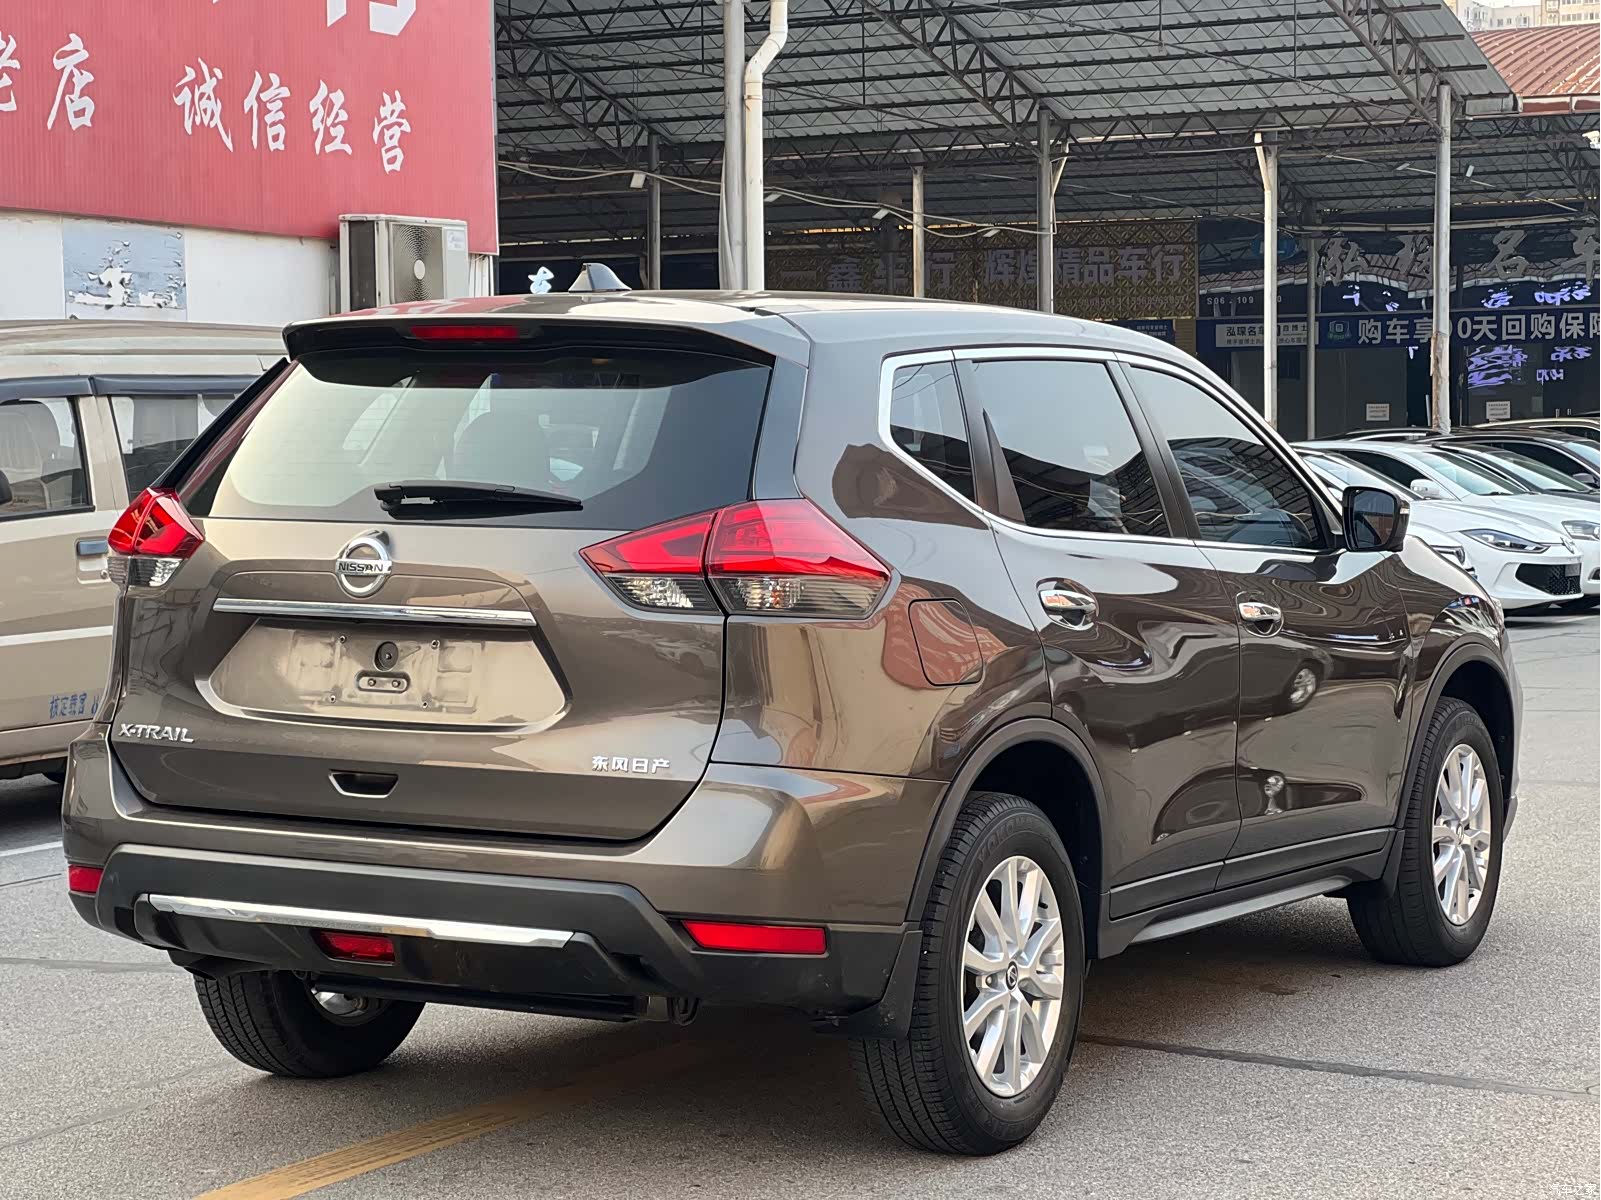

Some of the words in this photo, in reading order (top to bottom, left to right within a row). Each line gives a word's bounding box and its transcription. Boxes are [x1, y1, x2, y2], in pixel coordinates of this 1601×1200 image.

[172, 57, 412, 174] 诚信经营
[1357, 312, 1601, 345] 购车享0天回购保
[338, 561, 384, 572] NISSAN
[50, 692, 88, 719] 核定载客
[118, 722, 196, 744] X-TRAIL
[591, 755, 671, 774] 东风日产
